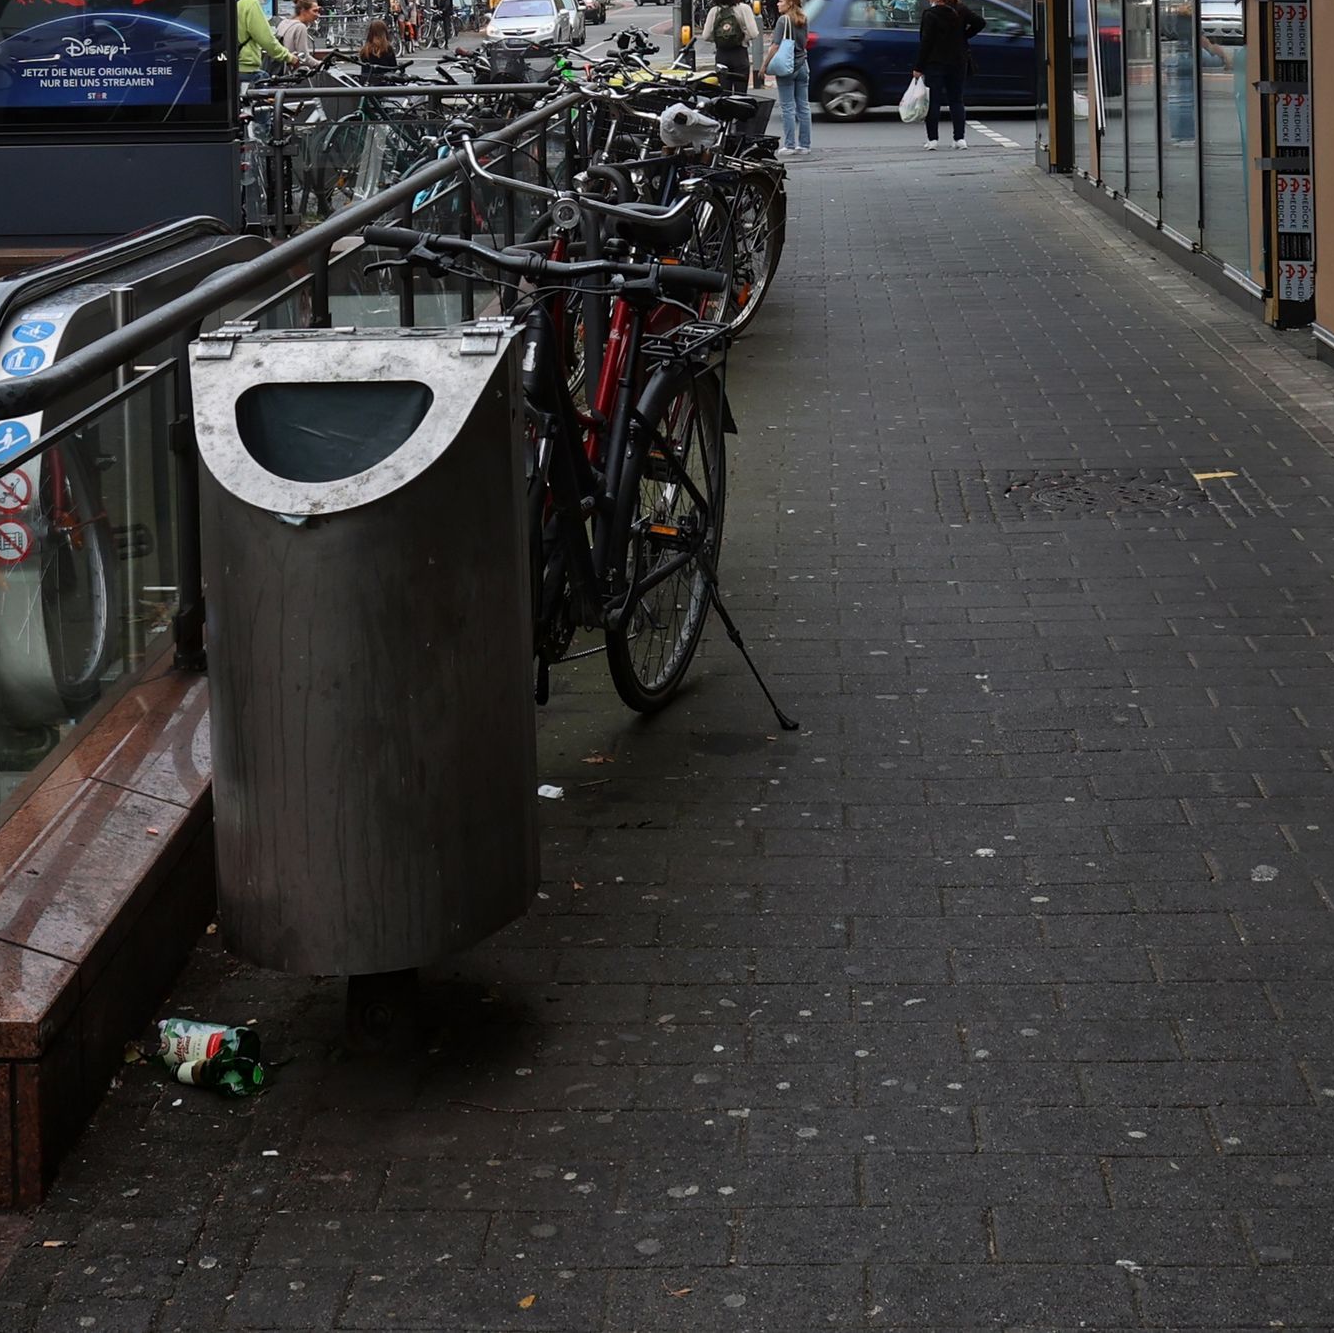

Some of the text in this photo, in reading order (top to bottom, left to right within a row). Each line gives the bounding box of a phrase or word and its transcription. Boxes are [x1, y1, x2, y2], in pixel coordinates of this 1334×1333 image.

[62, 36, 132, 62] Disney+
[21, 66, 173, 78] JETZT DIE NEUE ORIGINAL SERIE
[40, 77, 154, 88] NUR BEI UNS STREAMEN
